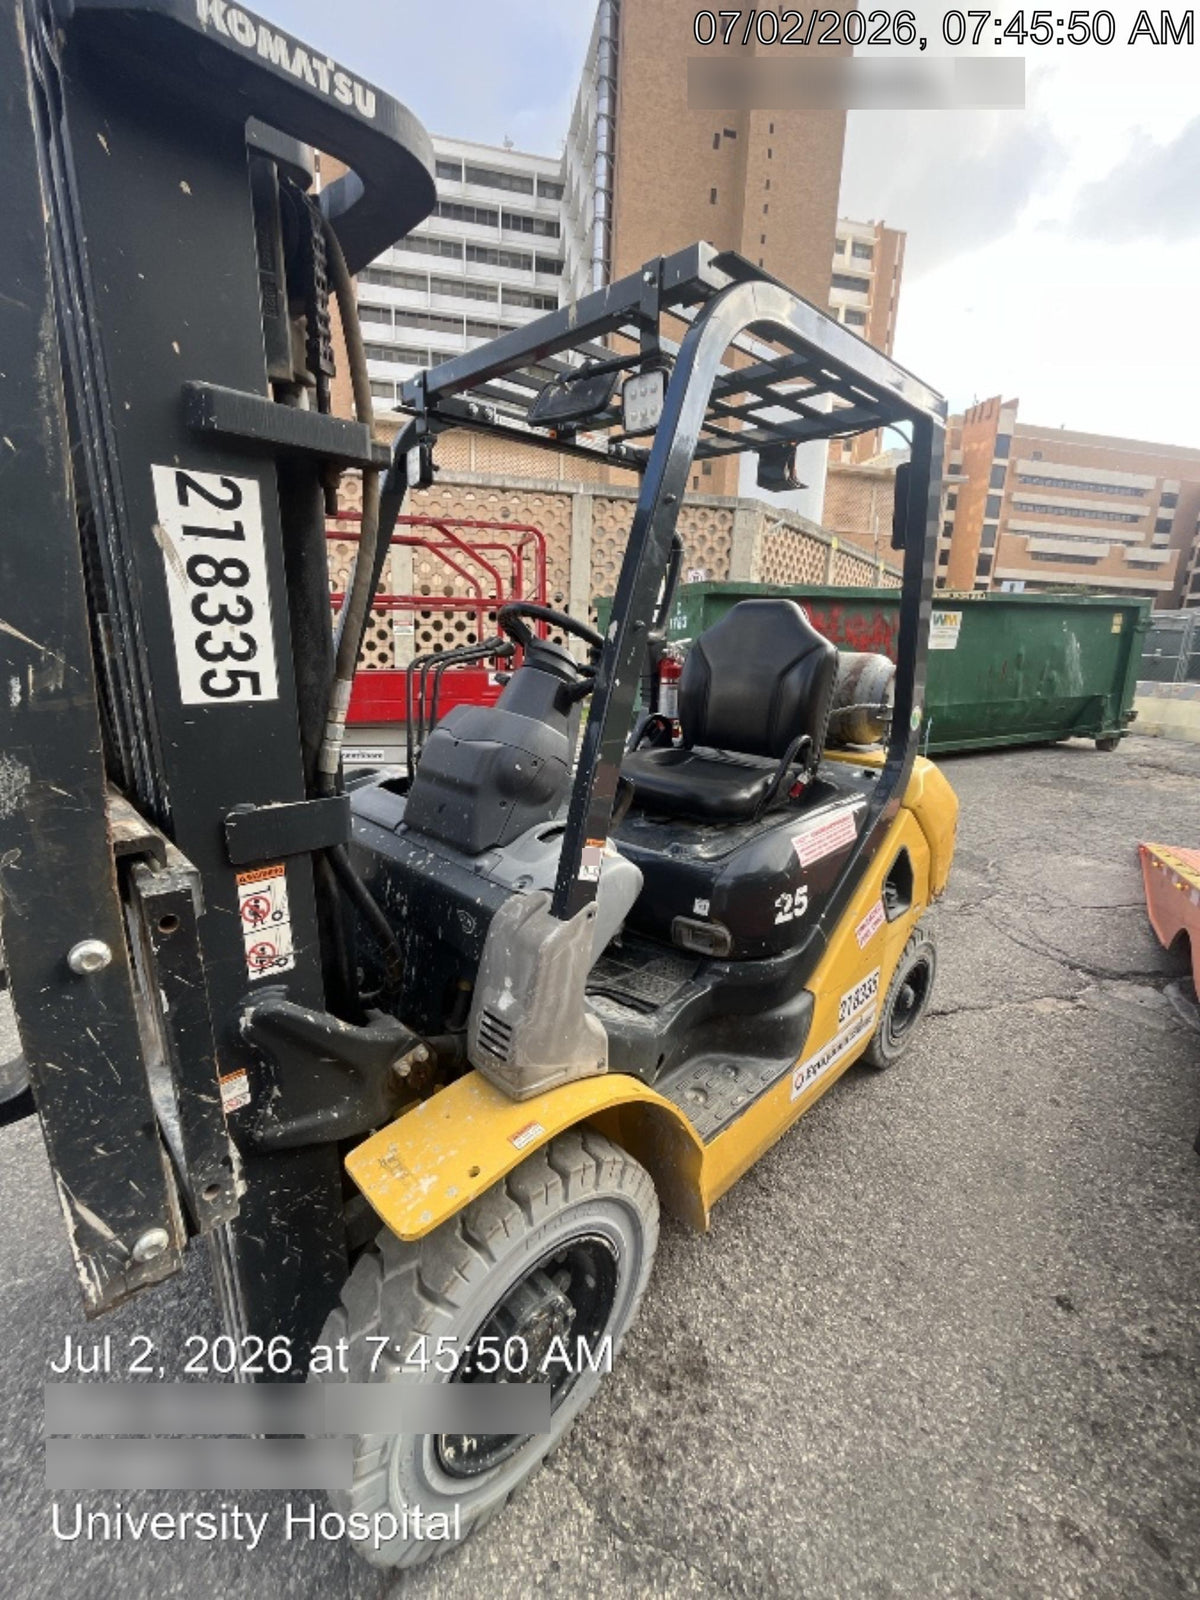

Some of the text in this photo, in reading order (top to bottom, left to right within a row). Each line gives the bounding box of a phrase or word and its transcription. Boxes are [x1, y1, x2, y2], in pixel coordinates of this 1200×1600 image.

[196, 0, 377, 119] KOMATSU
[174, 469, 263, 699] 218335
[774, 884, 809, 926] 25
